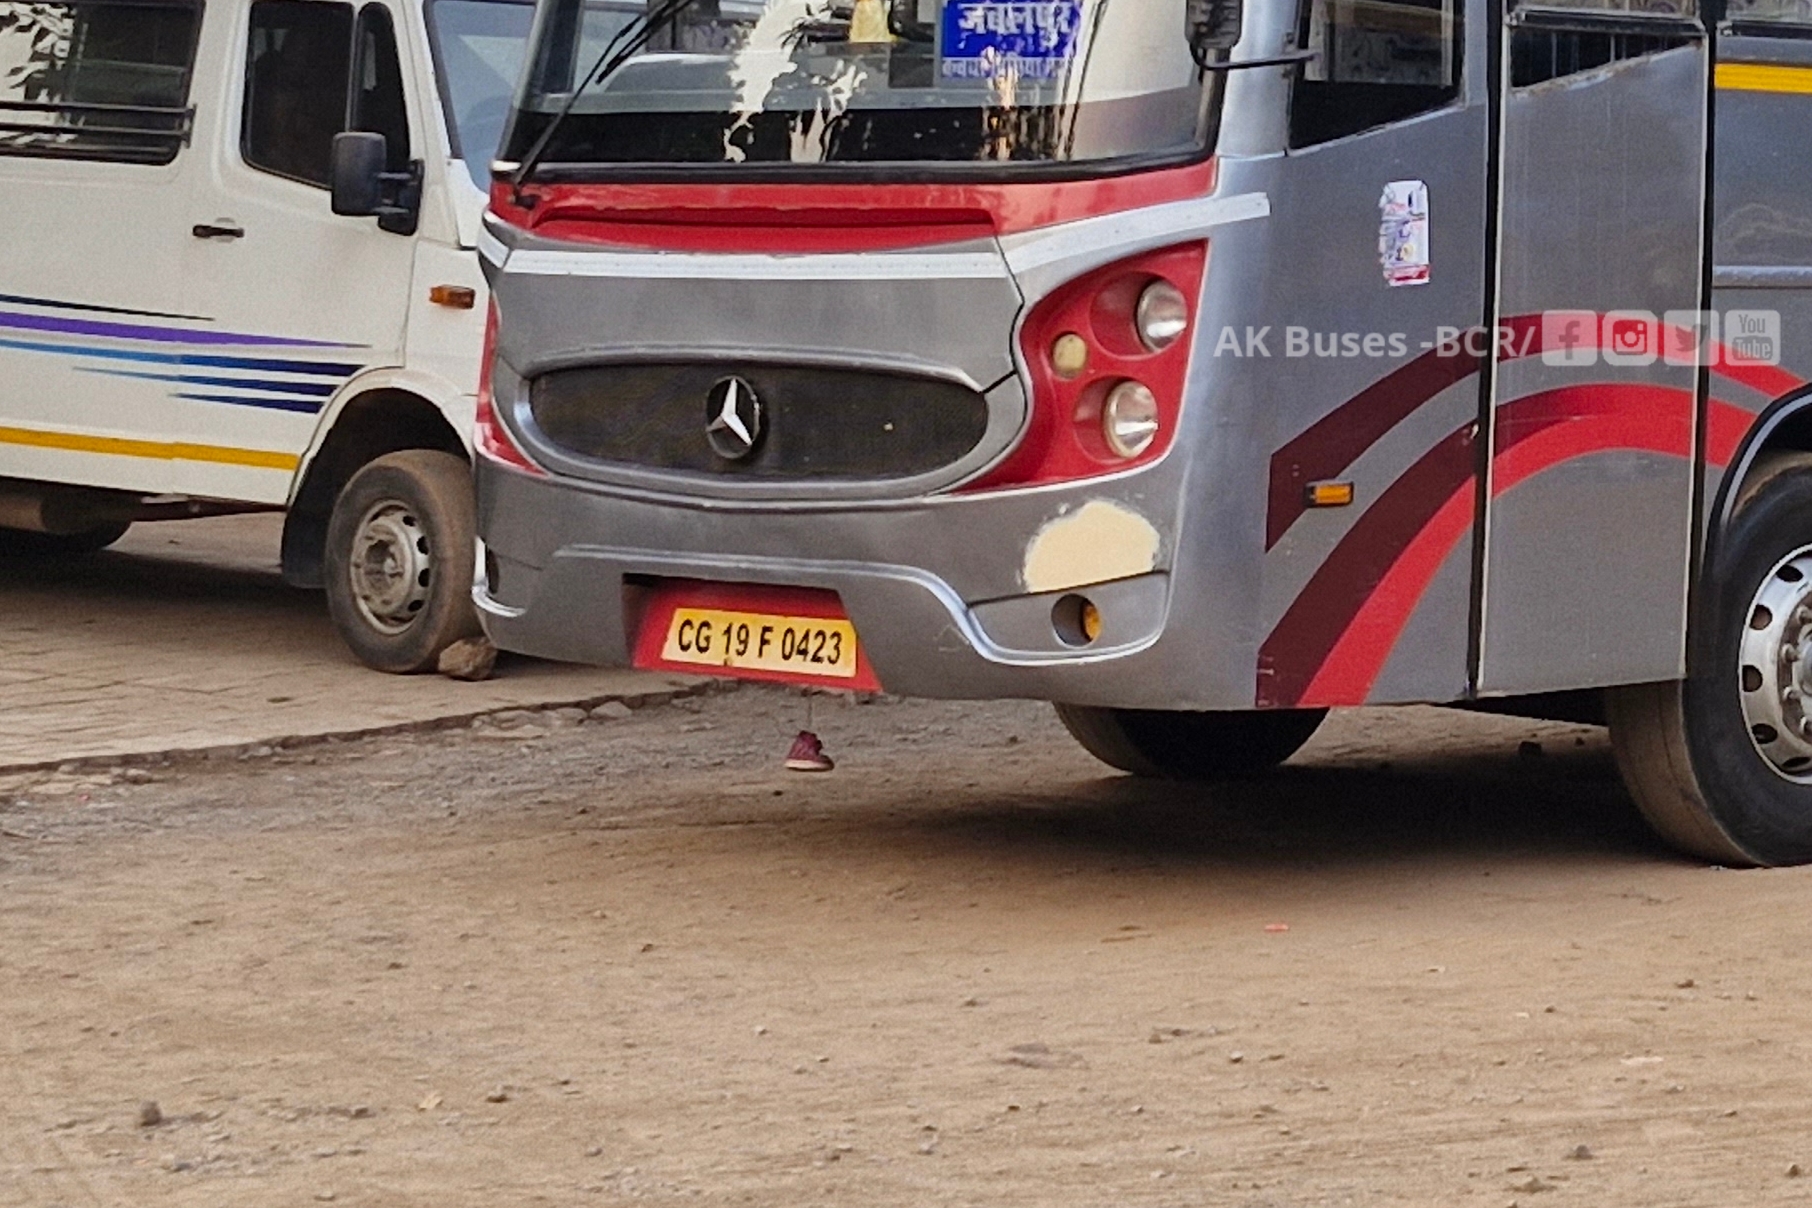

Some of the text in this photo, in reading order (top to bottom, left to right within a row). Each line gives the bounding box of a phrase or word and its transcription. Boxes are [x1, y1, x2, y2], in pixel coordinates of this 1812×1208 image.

[958, 2, 1074, 49] जबलपुर
[678, 619, 842, 665] CG 19 F 0423
